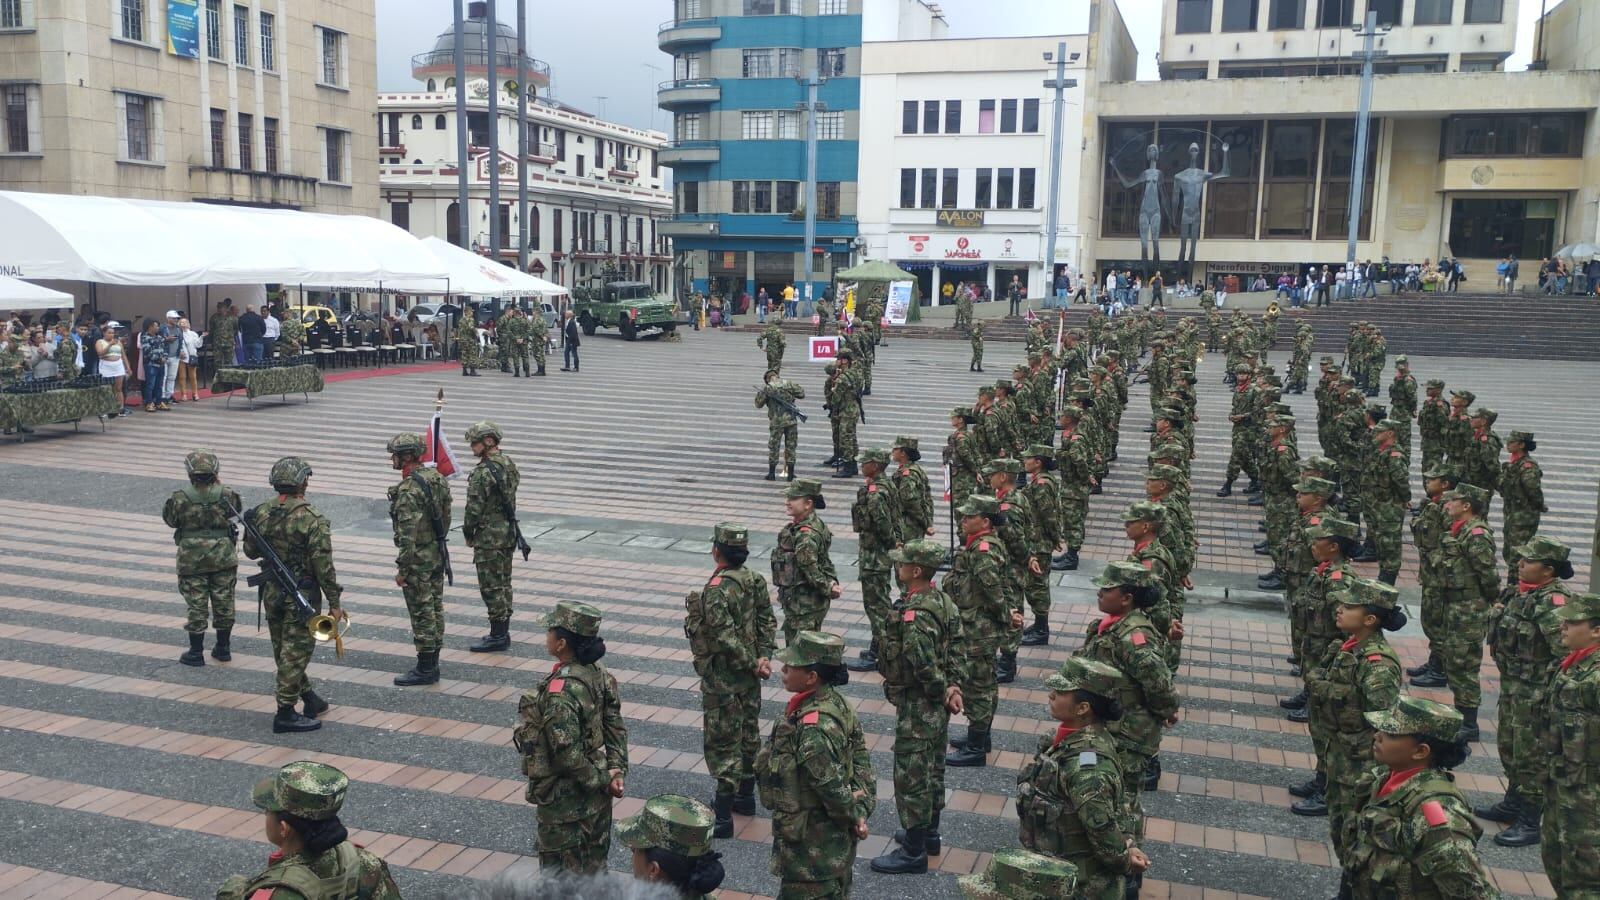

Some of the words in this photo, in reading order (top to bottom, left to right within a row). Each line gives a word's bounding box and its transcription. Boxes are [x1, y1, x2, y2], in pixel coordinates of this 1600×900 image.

[938, 210, 983, 225] AVALON
[1208, 263, 1256, 272] Macrofoto
[366, 286, 402, 295] NACONAL
